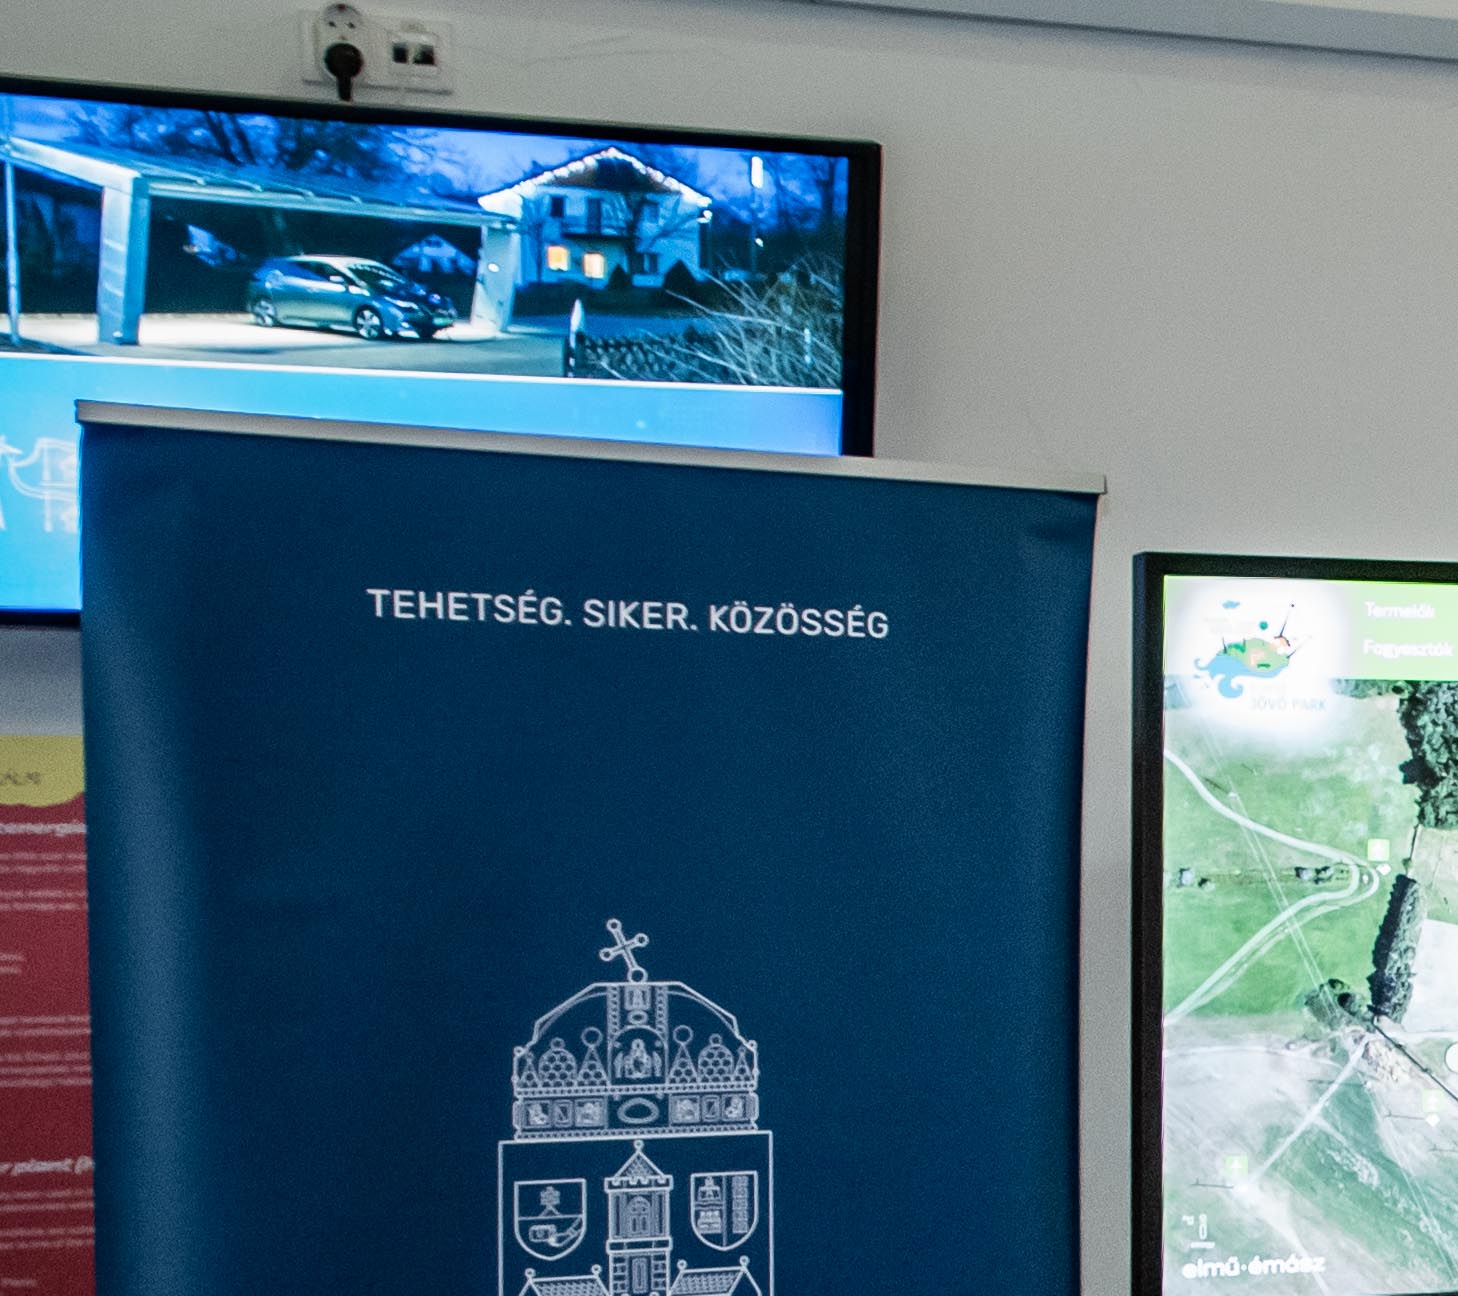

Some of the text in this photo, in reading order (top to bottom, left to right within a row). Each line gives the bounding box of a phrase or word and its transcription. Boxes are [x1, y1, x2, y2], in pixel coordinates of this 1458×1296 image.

[366, 588, 890, 638] TEHETSÉG. SIKER. KÖZÖSSÉG
